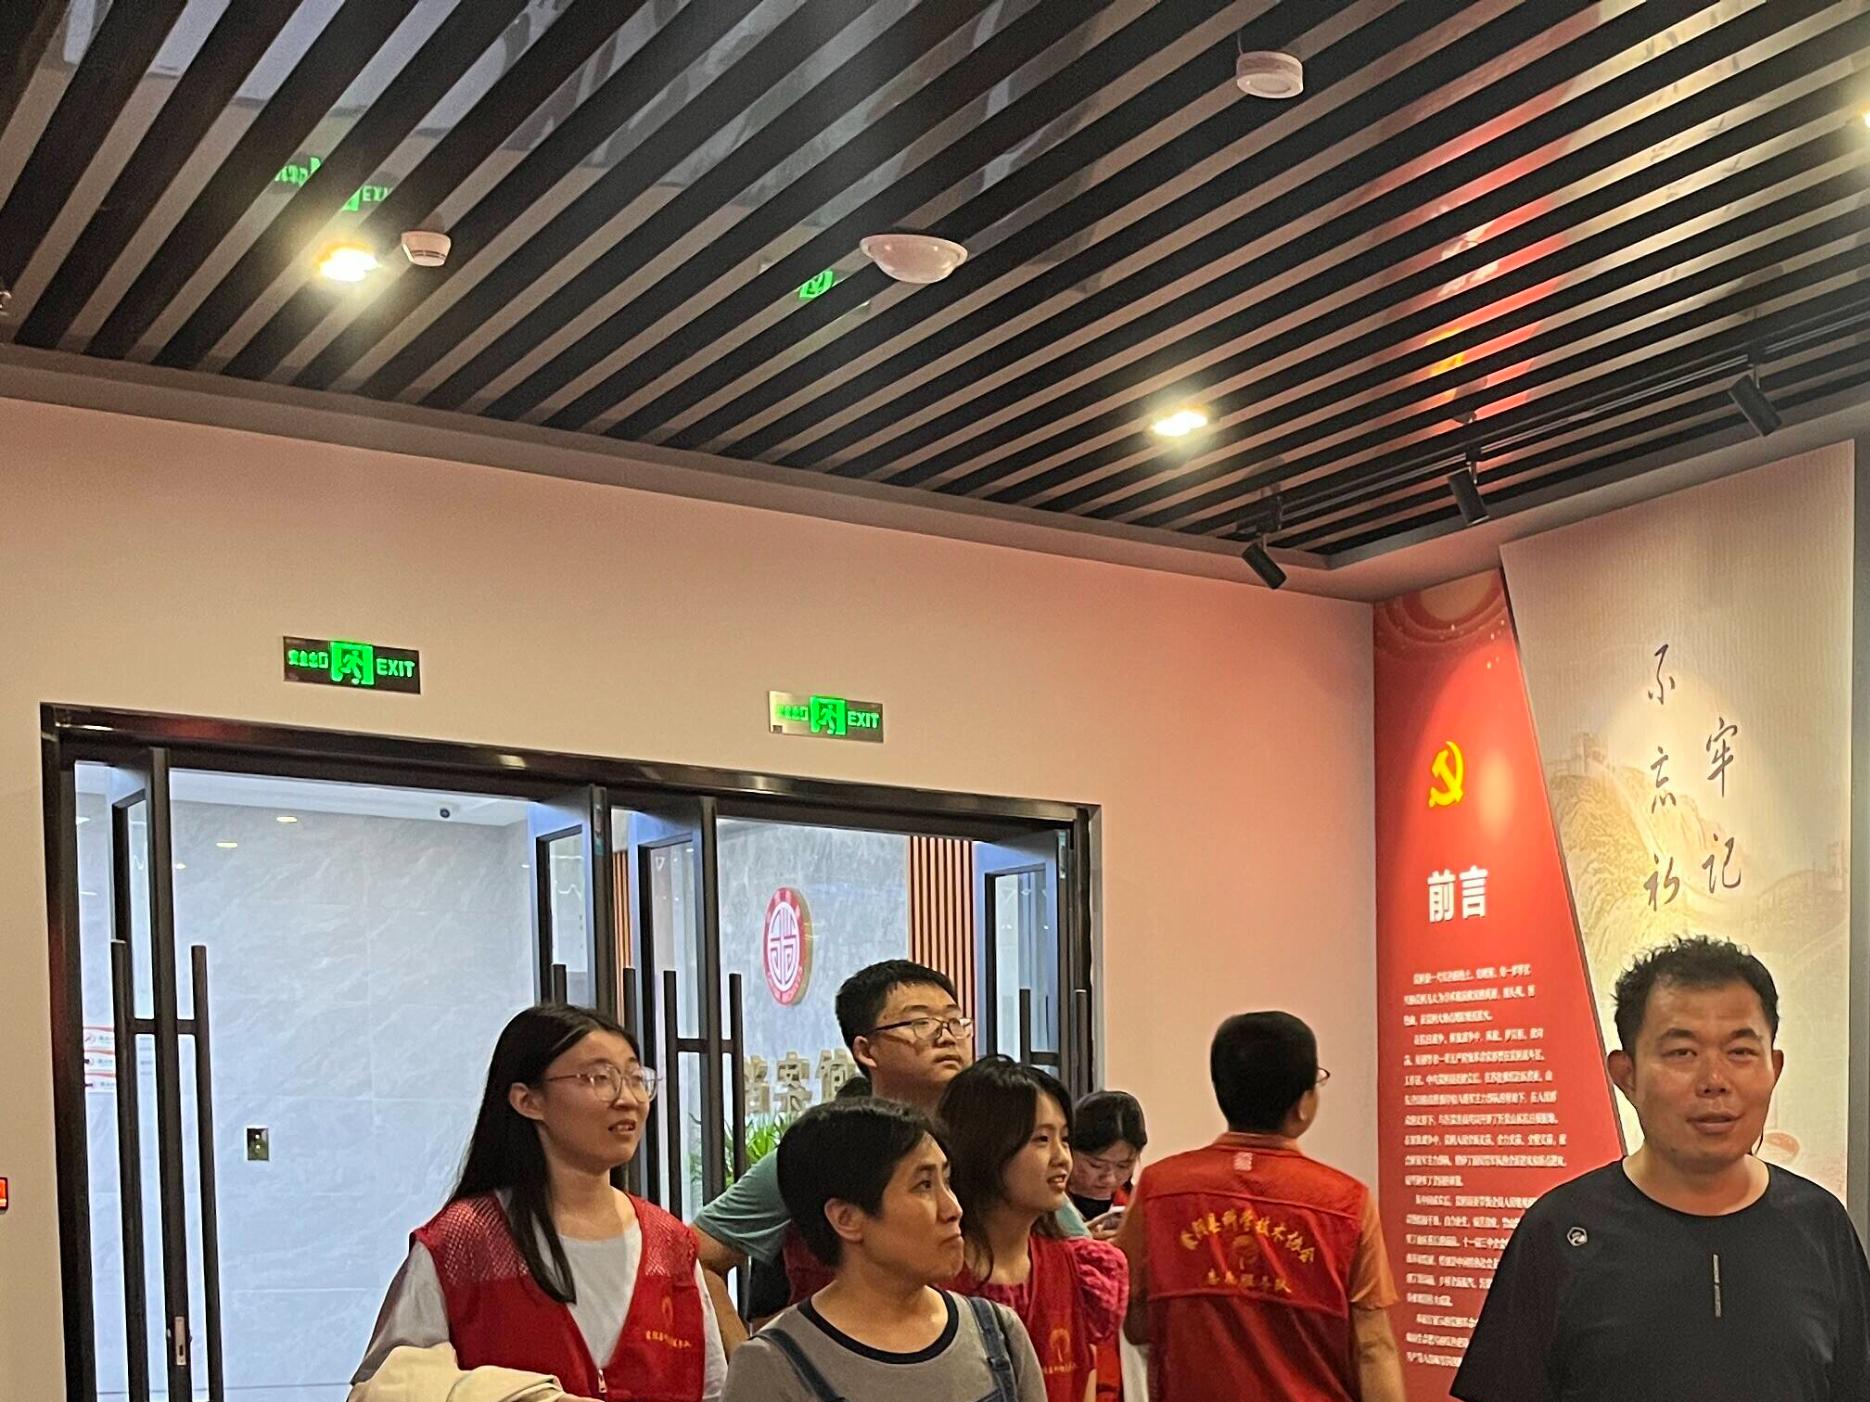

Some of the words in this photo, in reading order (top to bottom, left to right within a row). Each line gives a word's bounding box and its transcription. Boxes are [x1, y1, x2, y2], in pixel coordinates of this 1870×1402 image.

[376, 658, 416, 678] EXIT
[847, 711, 880, 729] EXIT
[1427, 865, 1489, 923] 前言
